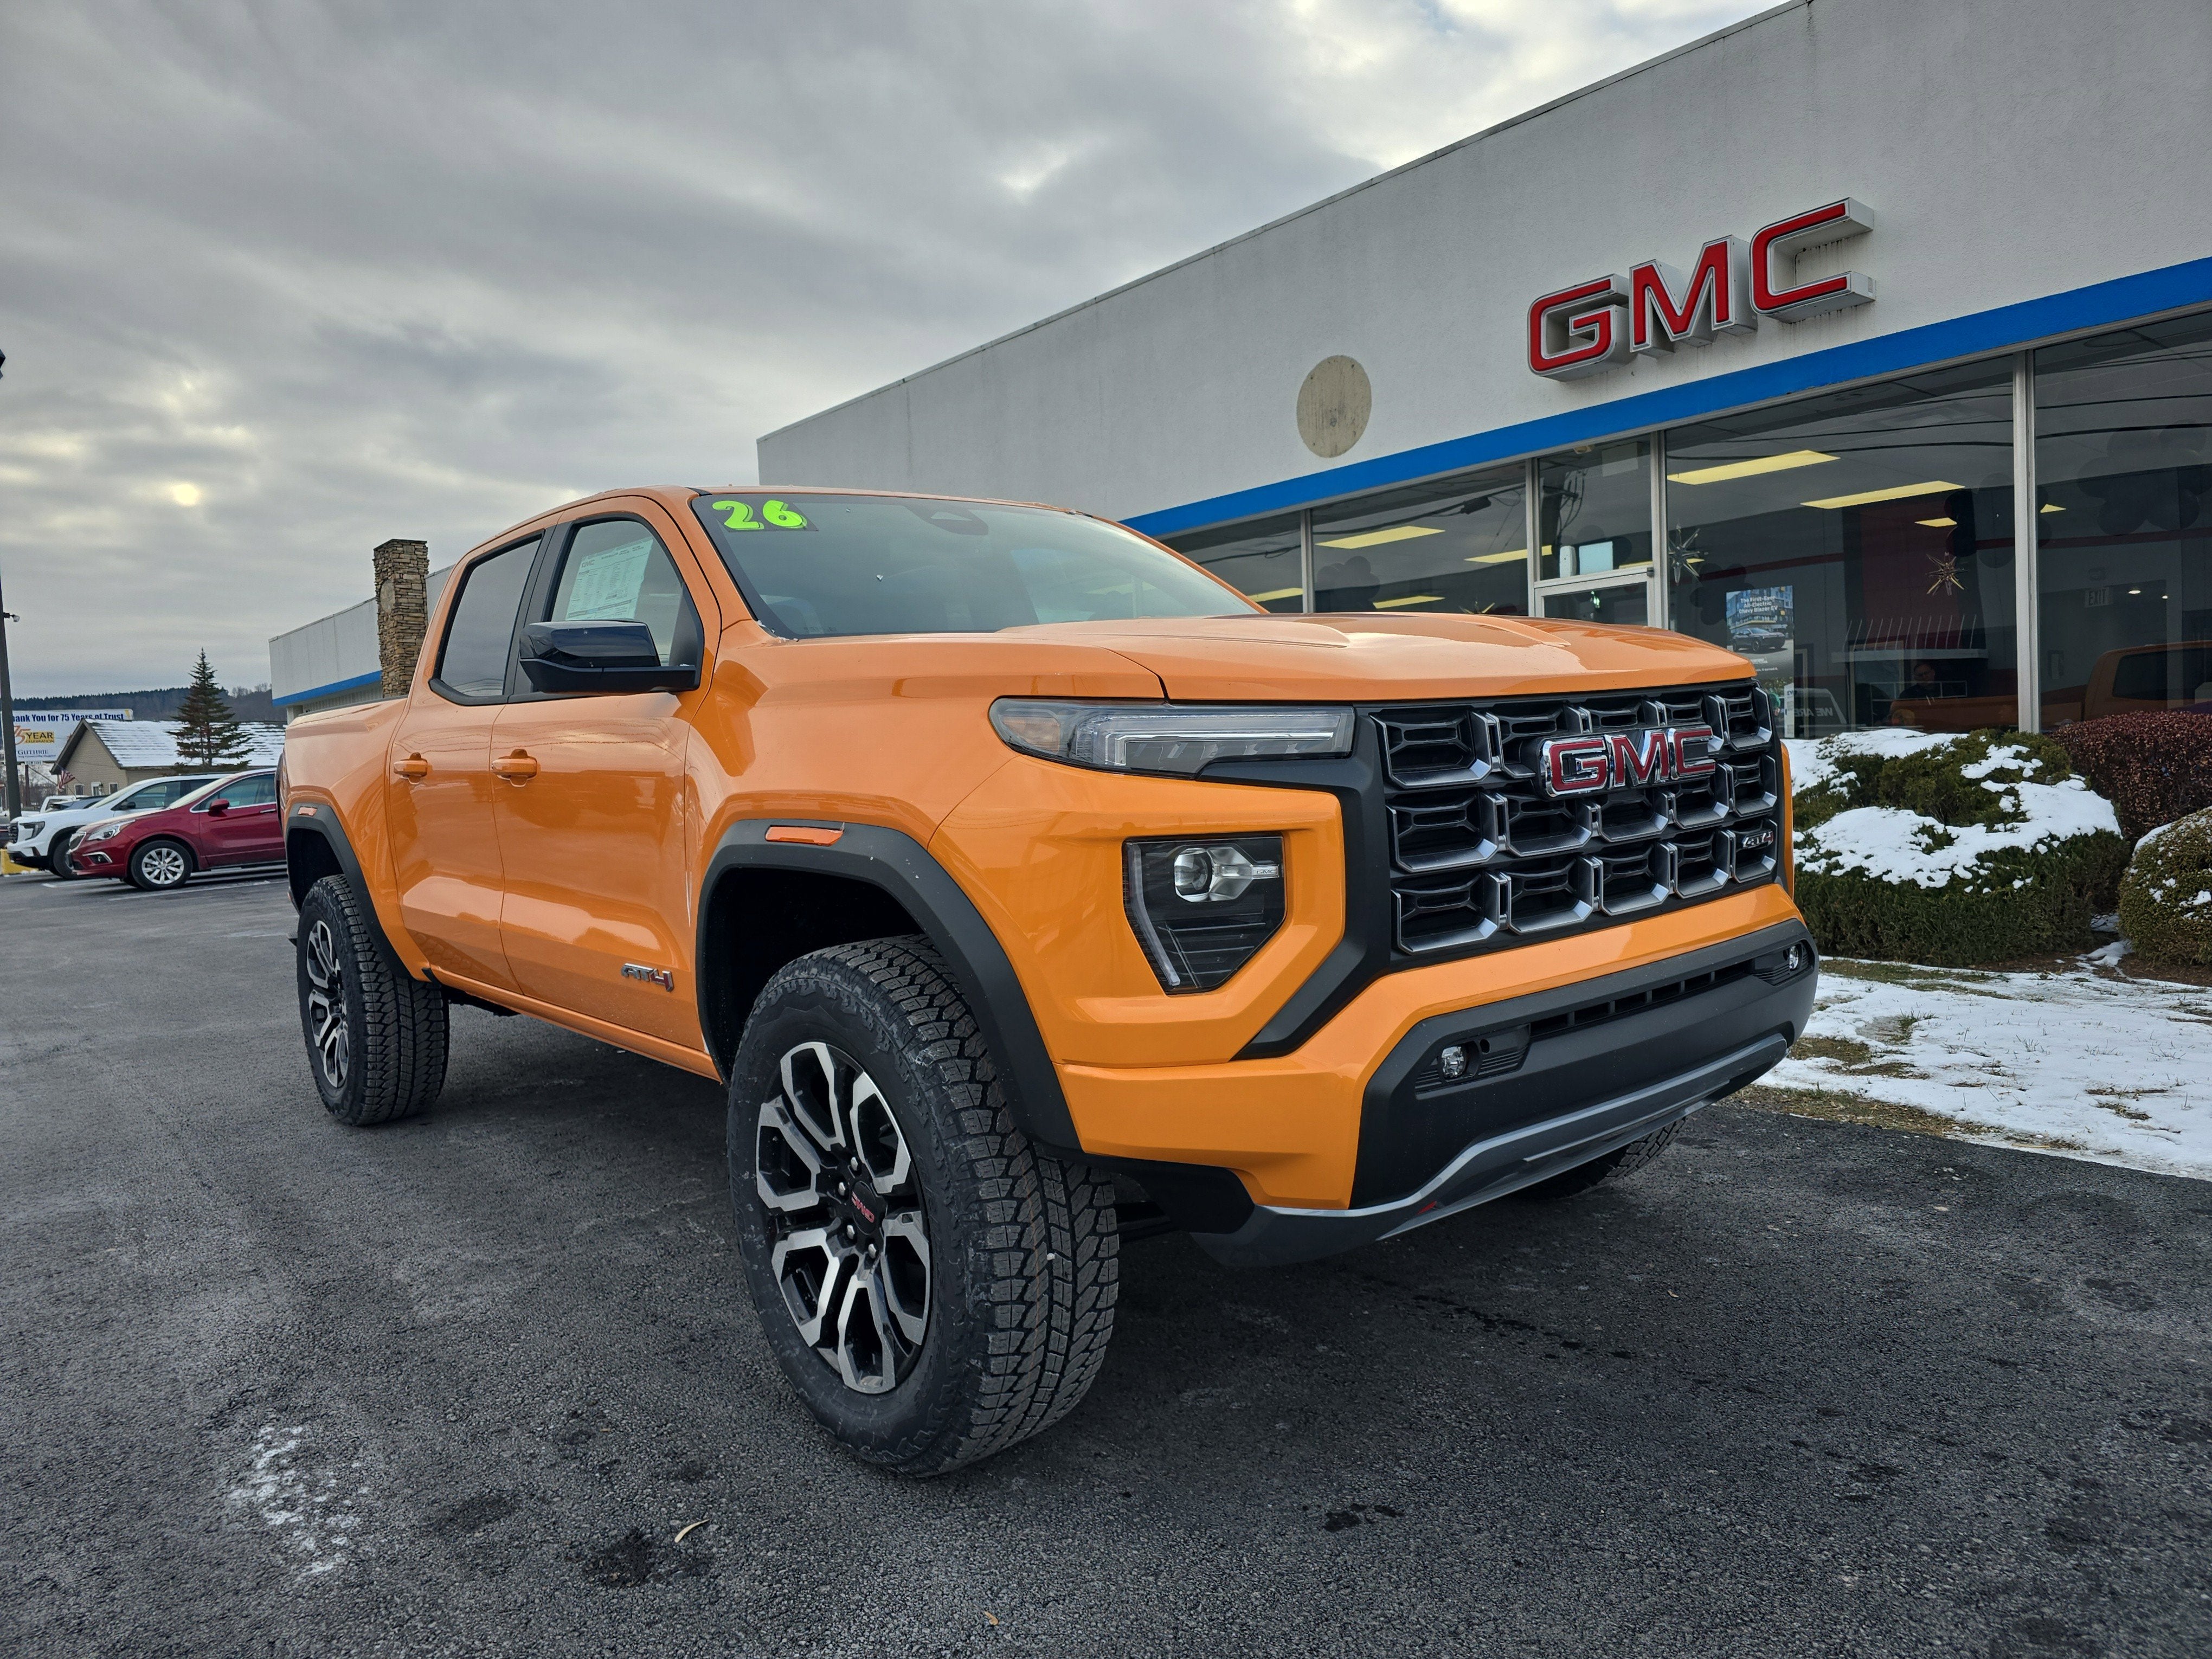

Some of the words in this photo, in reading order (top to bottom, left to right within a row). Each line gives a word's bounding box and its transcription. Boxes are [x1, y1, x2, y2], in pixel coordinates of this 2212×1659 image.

[1528, 197, 1853, 377] GMC
[712, 500, 808, 530] 26
[2088, 589, 2107, 606] EXIT
[31, 714, 46, 722] You
[48, 714, 59, 722] for
[60, 713, 69, 722] 75
[1542, 728, 1716, 798] GMC
[1742, 831, 1774, 848] AT4
[621, 962, 674, 993] AT4
[851, 1191, 875, 1223] GMC
